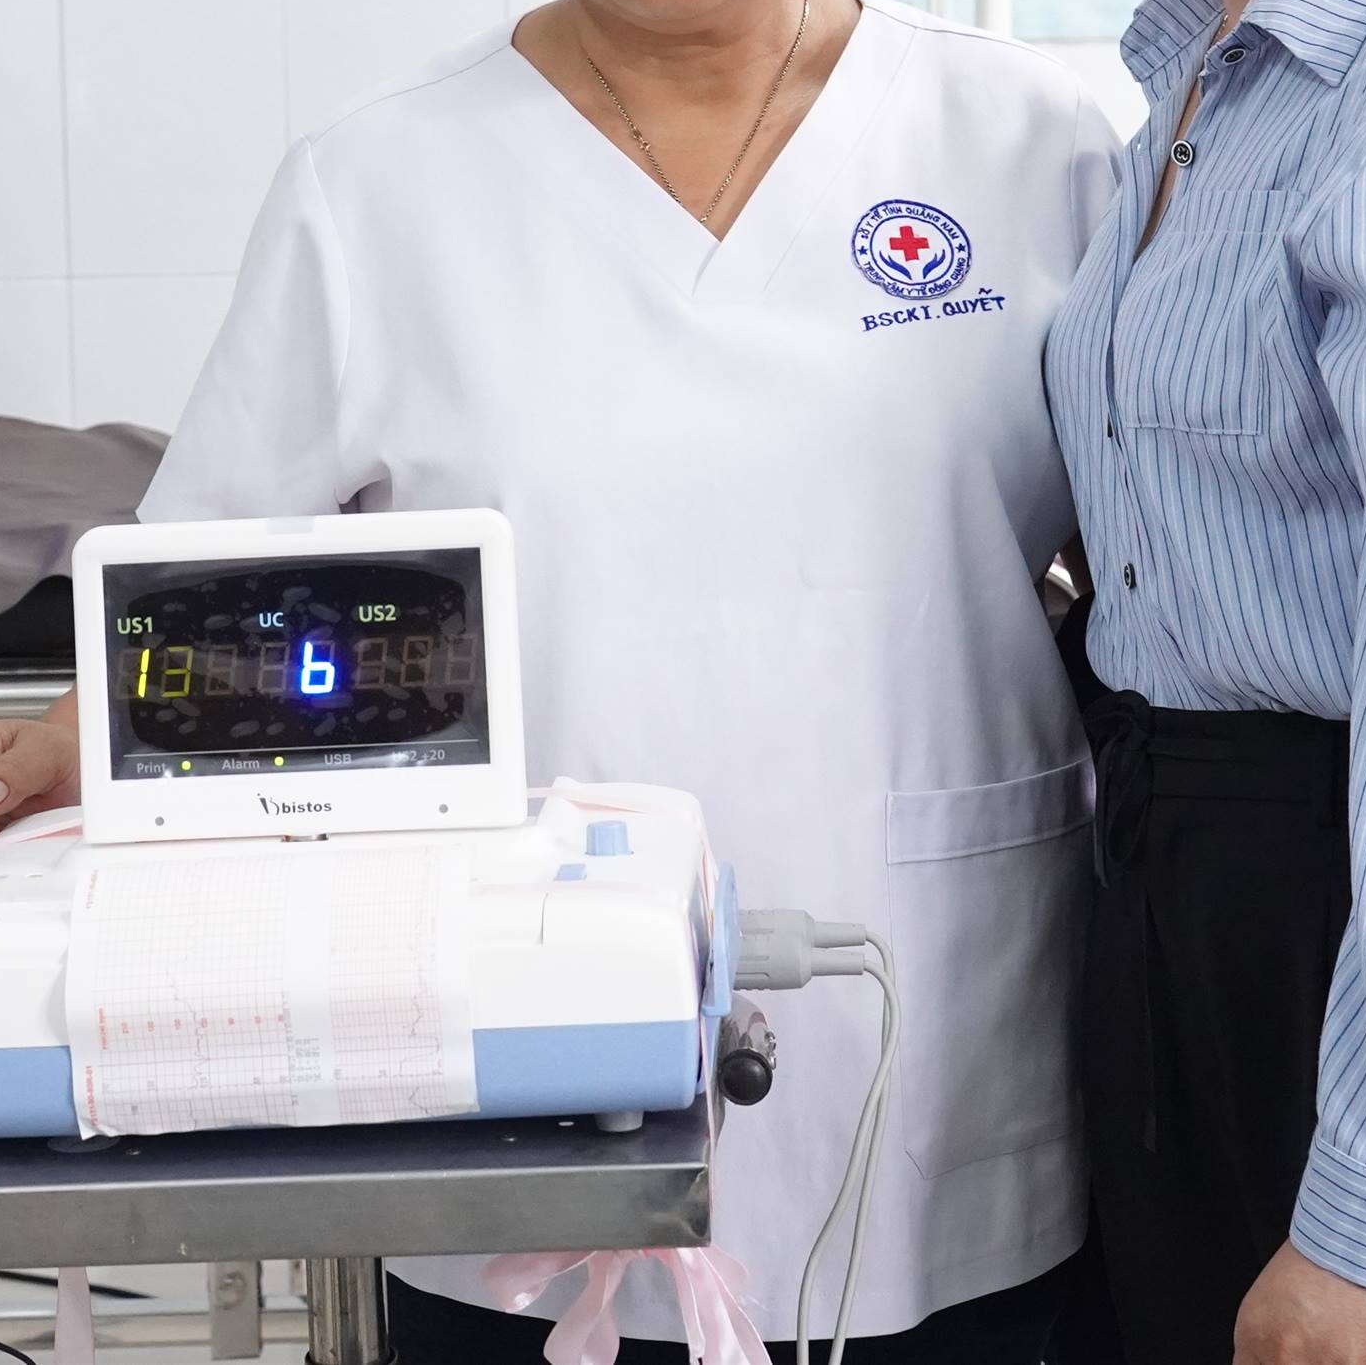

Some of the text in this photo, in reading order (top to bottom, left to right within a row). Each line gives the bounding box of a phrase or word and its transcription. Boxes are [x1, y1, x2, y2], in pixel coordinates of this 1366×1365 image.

[865, 220, 875, 228] Y
[905, 206, 941, 223] QUẢNG
[940, 221, 960, 240] NAM
[864, 260, 885, 284] TRUNG
[906, 287, 915, 296] Y
[949, 256, 966, 281] GIANG
[116, 604, 398, 635] US1 UC US2
[136, 761, 167, 776] Print
[221, 757, 261, 771] Alarm
[323, 752, 353, 766] USB
[281, 800, 333, 816] bistos
